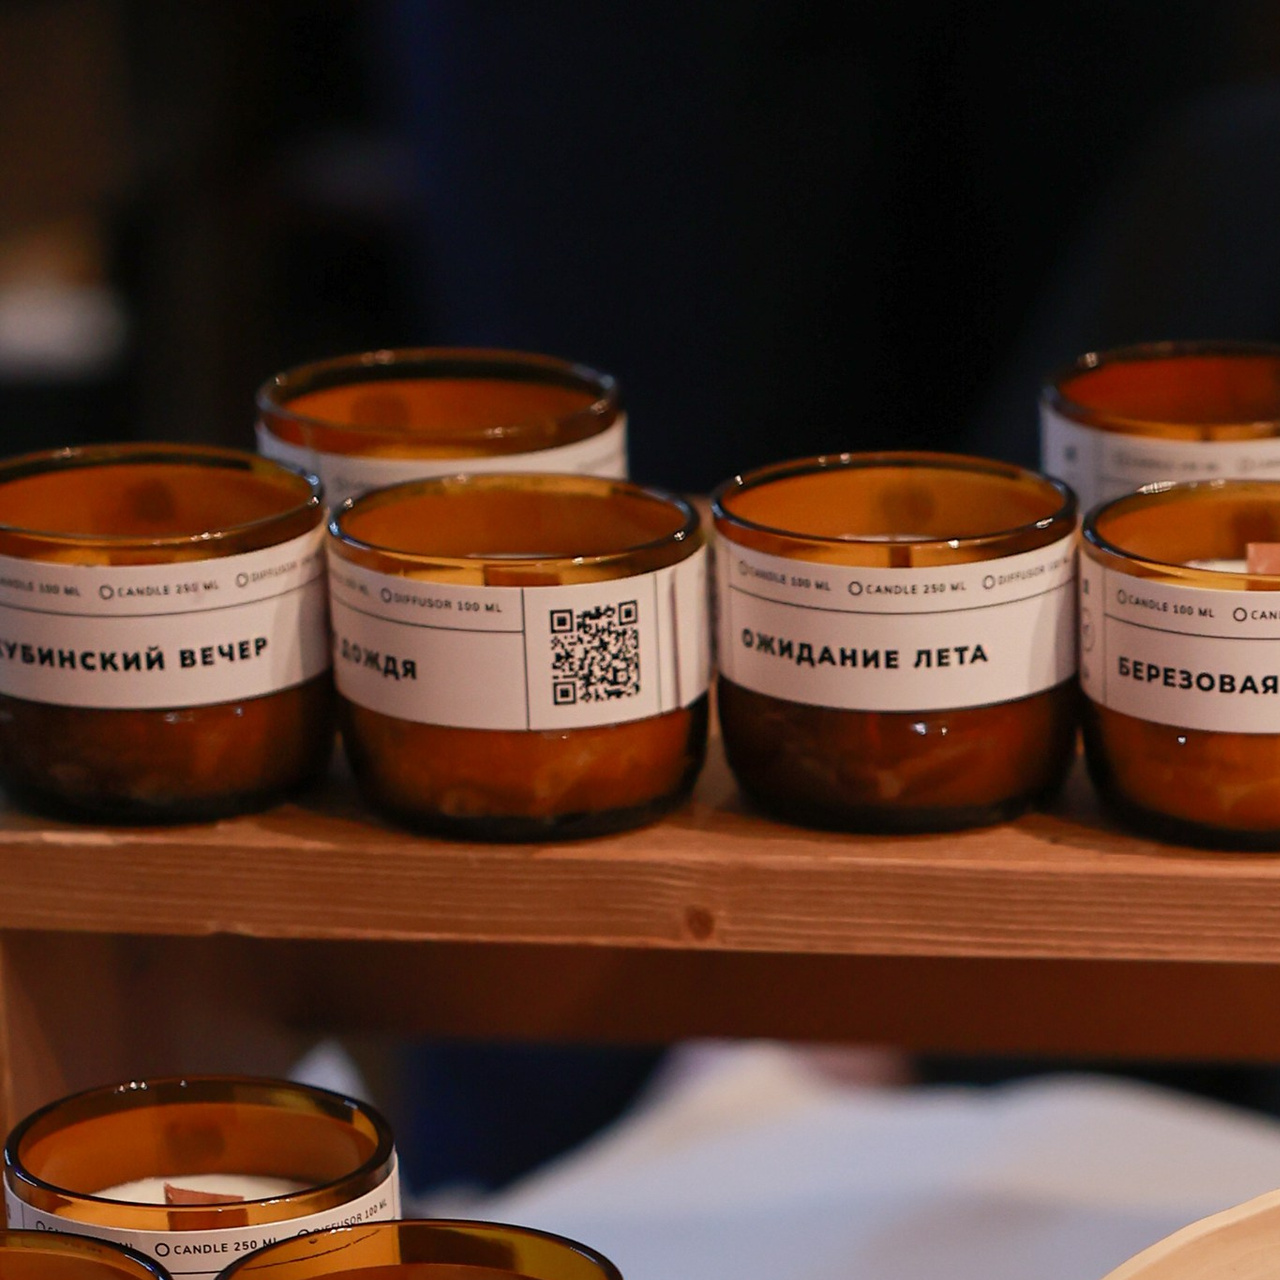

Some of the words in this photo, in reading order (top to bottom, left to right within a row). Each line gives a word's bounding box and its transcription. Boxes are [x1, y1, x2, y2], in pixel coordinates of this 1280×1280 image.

[815, 580, 831, 591] ML
[866, 585, 917, 596] CANDLE
[923, 584, 946, 594] 250
[951, 581, 967, 591] ML
[485, 603, 502, 613] ML
[1129, 594, 1168, 612] CANDLE
[1198, 608, 1215, 619] ML
[179, 637, 268, 668] ВЕЧЕР
[342, 638, 417, 680] ДОЖДЯ
[742, 629, 900, 669] ОЖИДАНИЕ
[914, 644, 989, 669] ЛЕТА
[1118, 656, 1279, 694] БЕРЕЗОВАЯ
[365, 1204, 378, 1219] 100
[173, 1243, 229, 1255] CANDLE
[234, 1240, 258, 1252] 250
